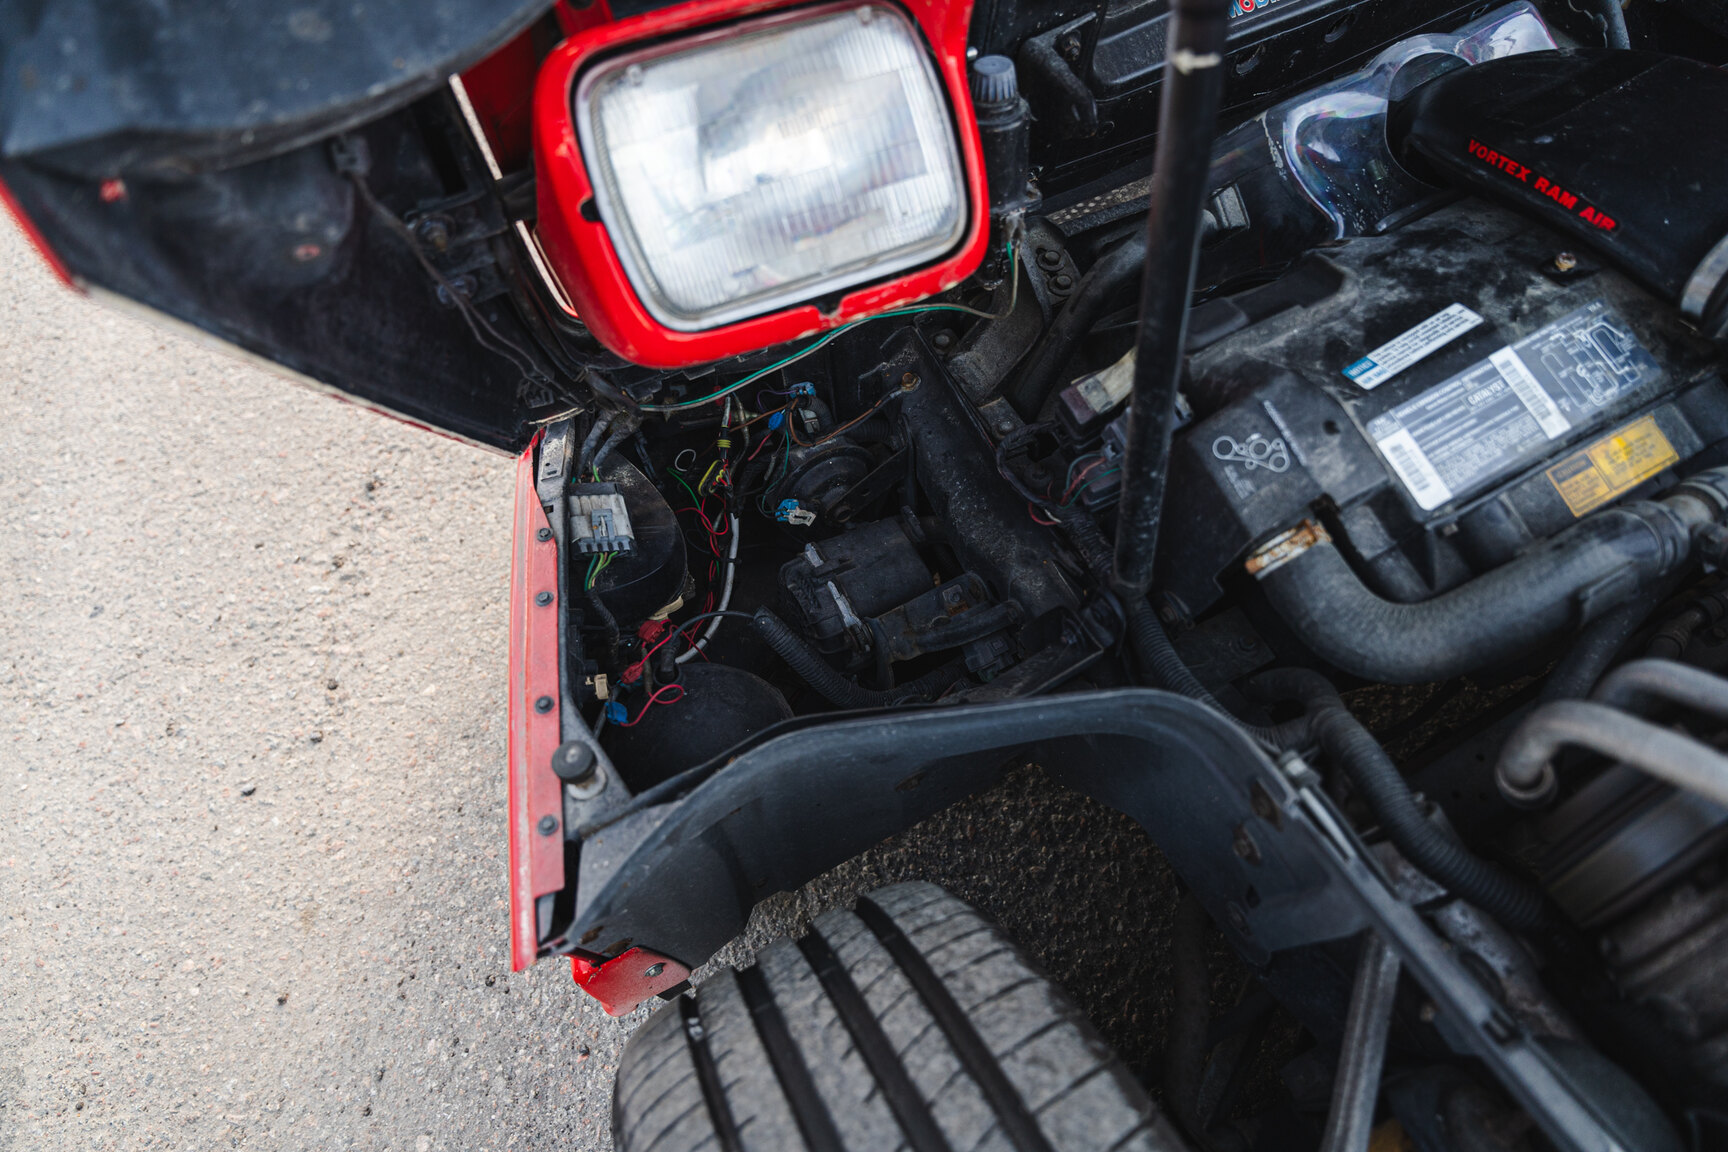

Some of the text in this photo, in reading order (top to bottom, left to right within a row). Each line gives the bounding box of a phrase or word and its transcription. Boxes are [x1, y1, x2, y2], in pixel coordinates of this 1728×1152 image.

[1468, 139, 1616, 231] VORTEX RAM AIR
